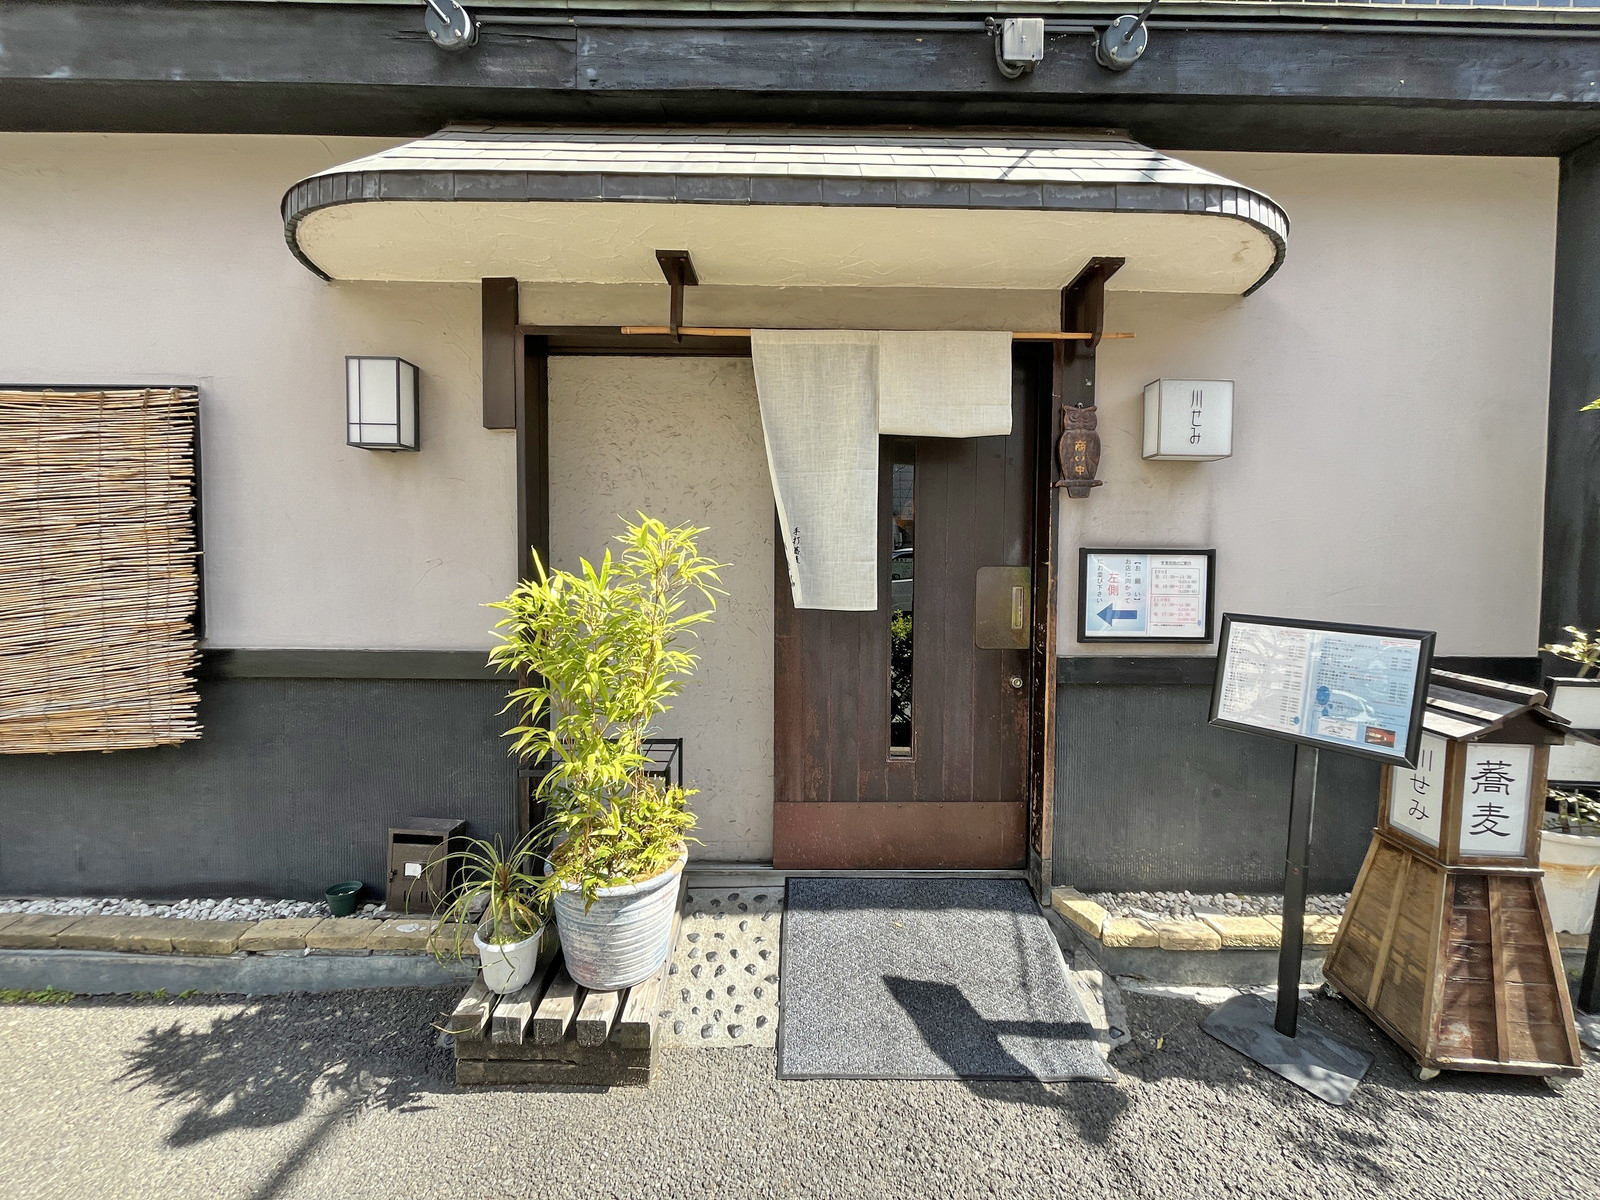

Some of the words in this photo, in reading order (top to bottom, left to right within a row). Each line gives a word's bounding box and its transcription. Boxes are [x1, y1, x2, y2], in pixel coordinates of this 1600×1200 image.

[1190, 389, 1203, 445] 川せみ
[1075, 440, 1086, 476] 商い中
[1107, 571, 1120, 597] 左側
[1469, 760, 1515, 837] 蕎麦
